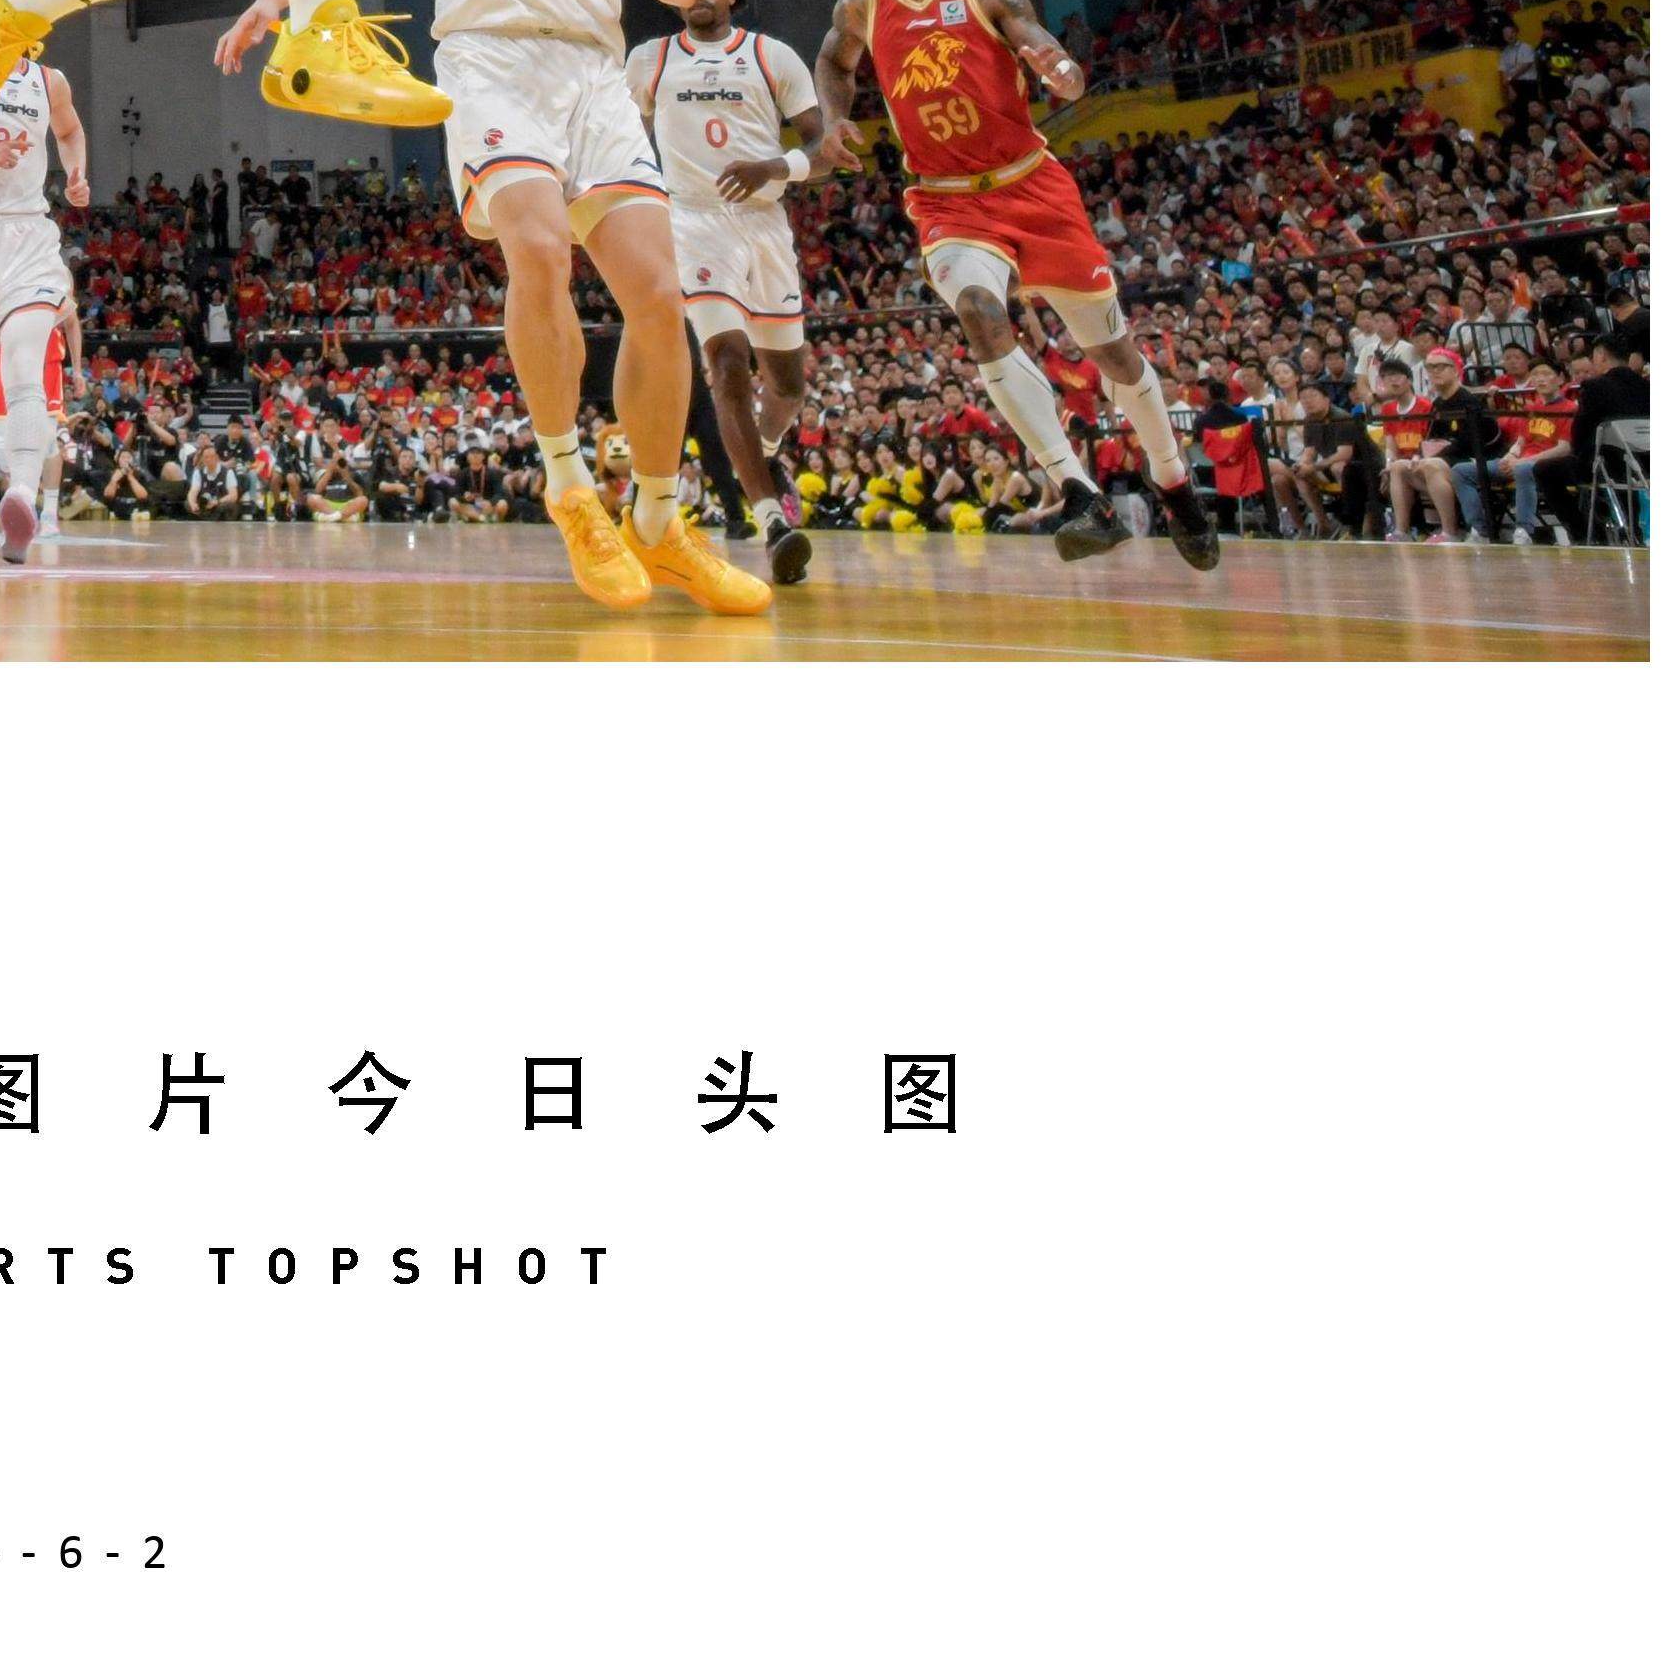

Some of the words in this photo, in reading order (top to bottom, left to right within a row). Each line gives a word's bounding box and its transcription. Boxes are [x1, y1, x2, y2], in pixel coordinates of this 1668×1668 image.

[677, 88, 744, 102] sharks
[705, 118, 728, 149] 0
[918, 96, 980, 142] 59
